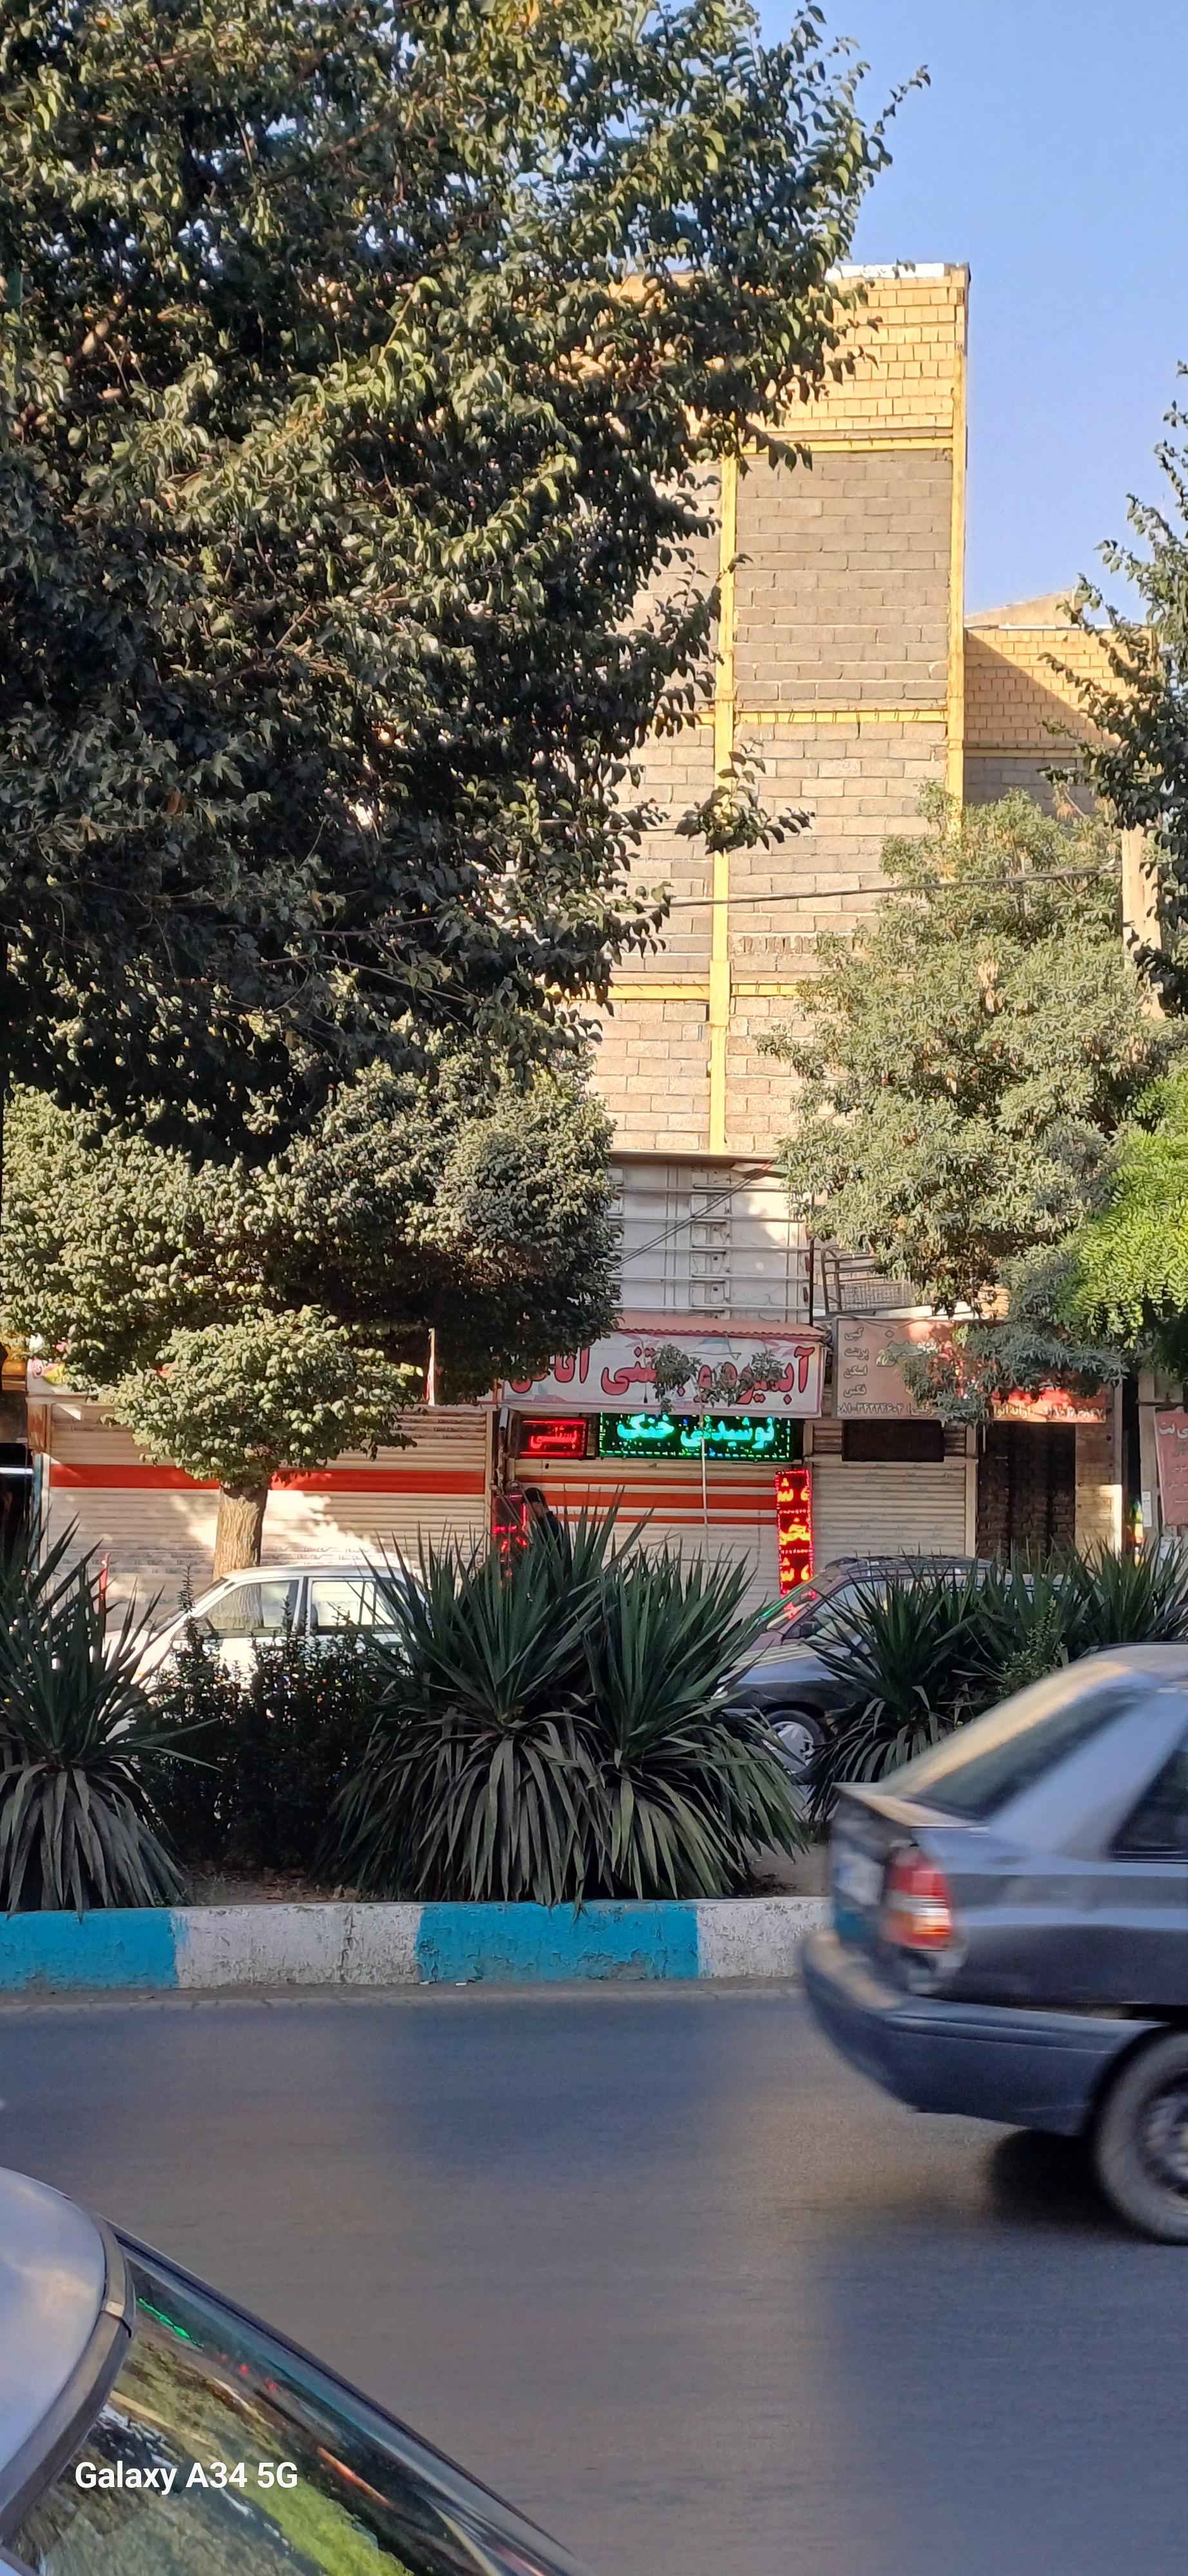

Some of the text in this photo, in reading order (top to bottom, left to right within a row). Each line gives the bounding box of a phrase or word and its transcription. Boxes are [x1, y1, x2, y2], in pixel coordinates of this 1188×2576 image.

[843, 1364, 868, 1379] اسکن
[843, 1383, 867, 1398] فکس
[530, 1422, 578, 1450] بستنی
[617, 1414, 774, 1449] نوشیدنی خنک
